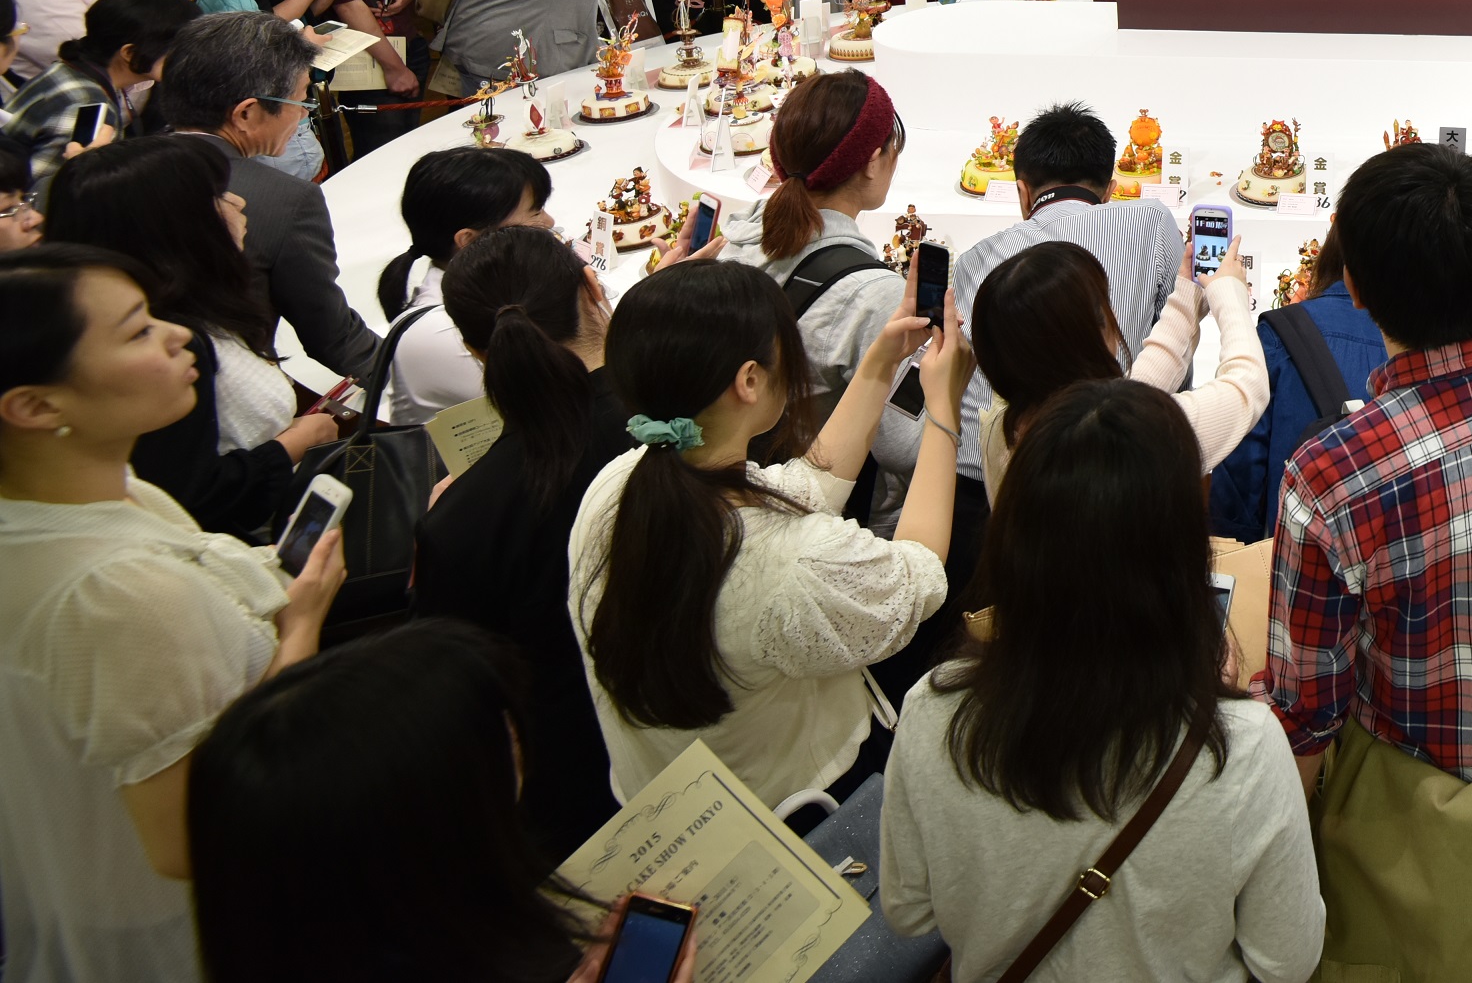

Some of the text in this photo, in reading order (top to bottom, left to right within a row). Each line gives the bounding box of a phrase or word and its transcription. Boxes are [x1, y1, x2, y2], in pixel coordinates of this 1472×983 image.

[1314, 157, 1327, 195] 金賞
[590, 254, 607, 271] 276
[626, 800, 723, 893] CAKE SHOW TOKYO
[629, 831, 662, 864] 2015
